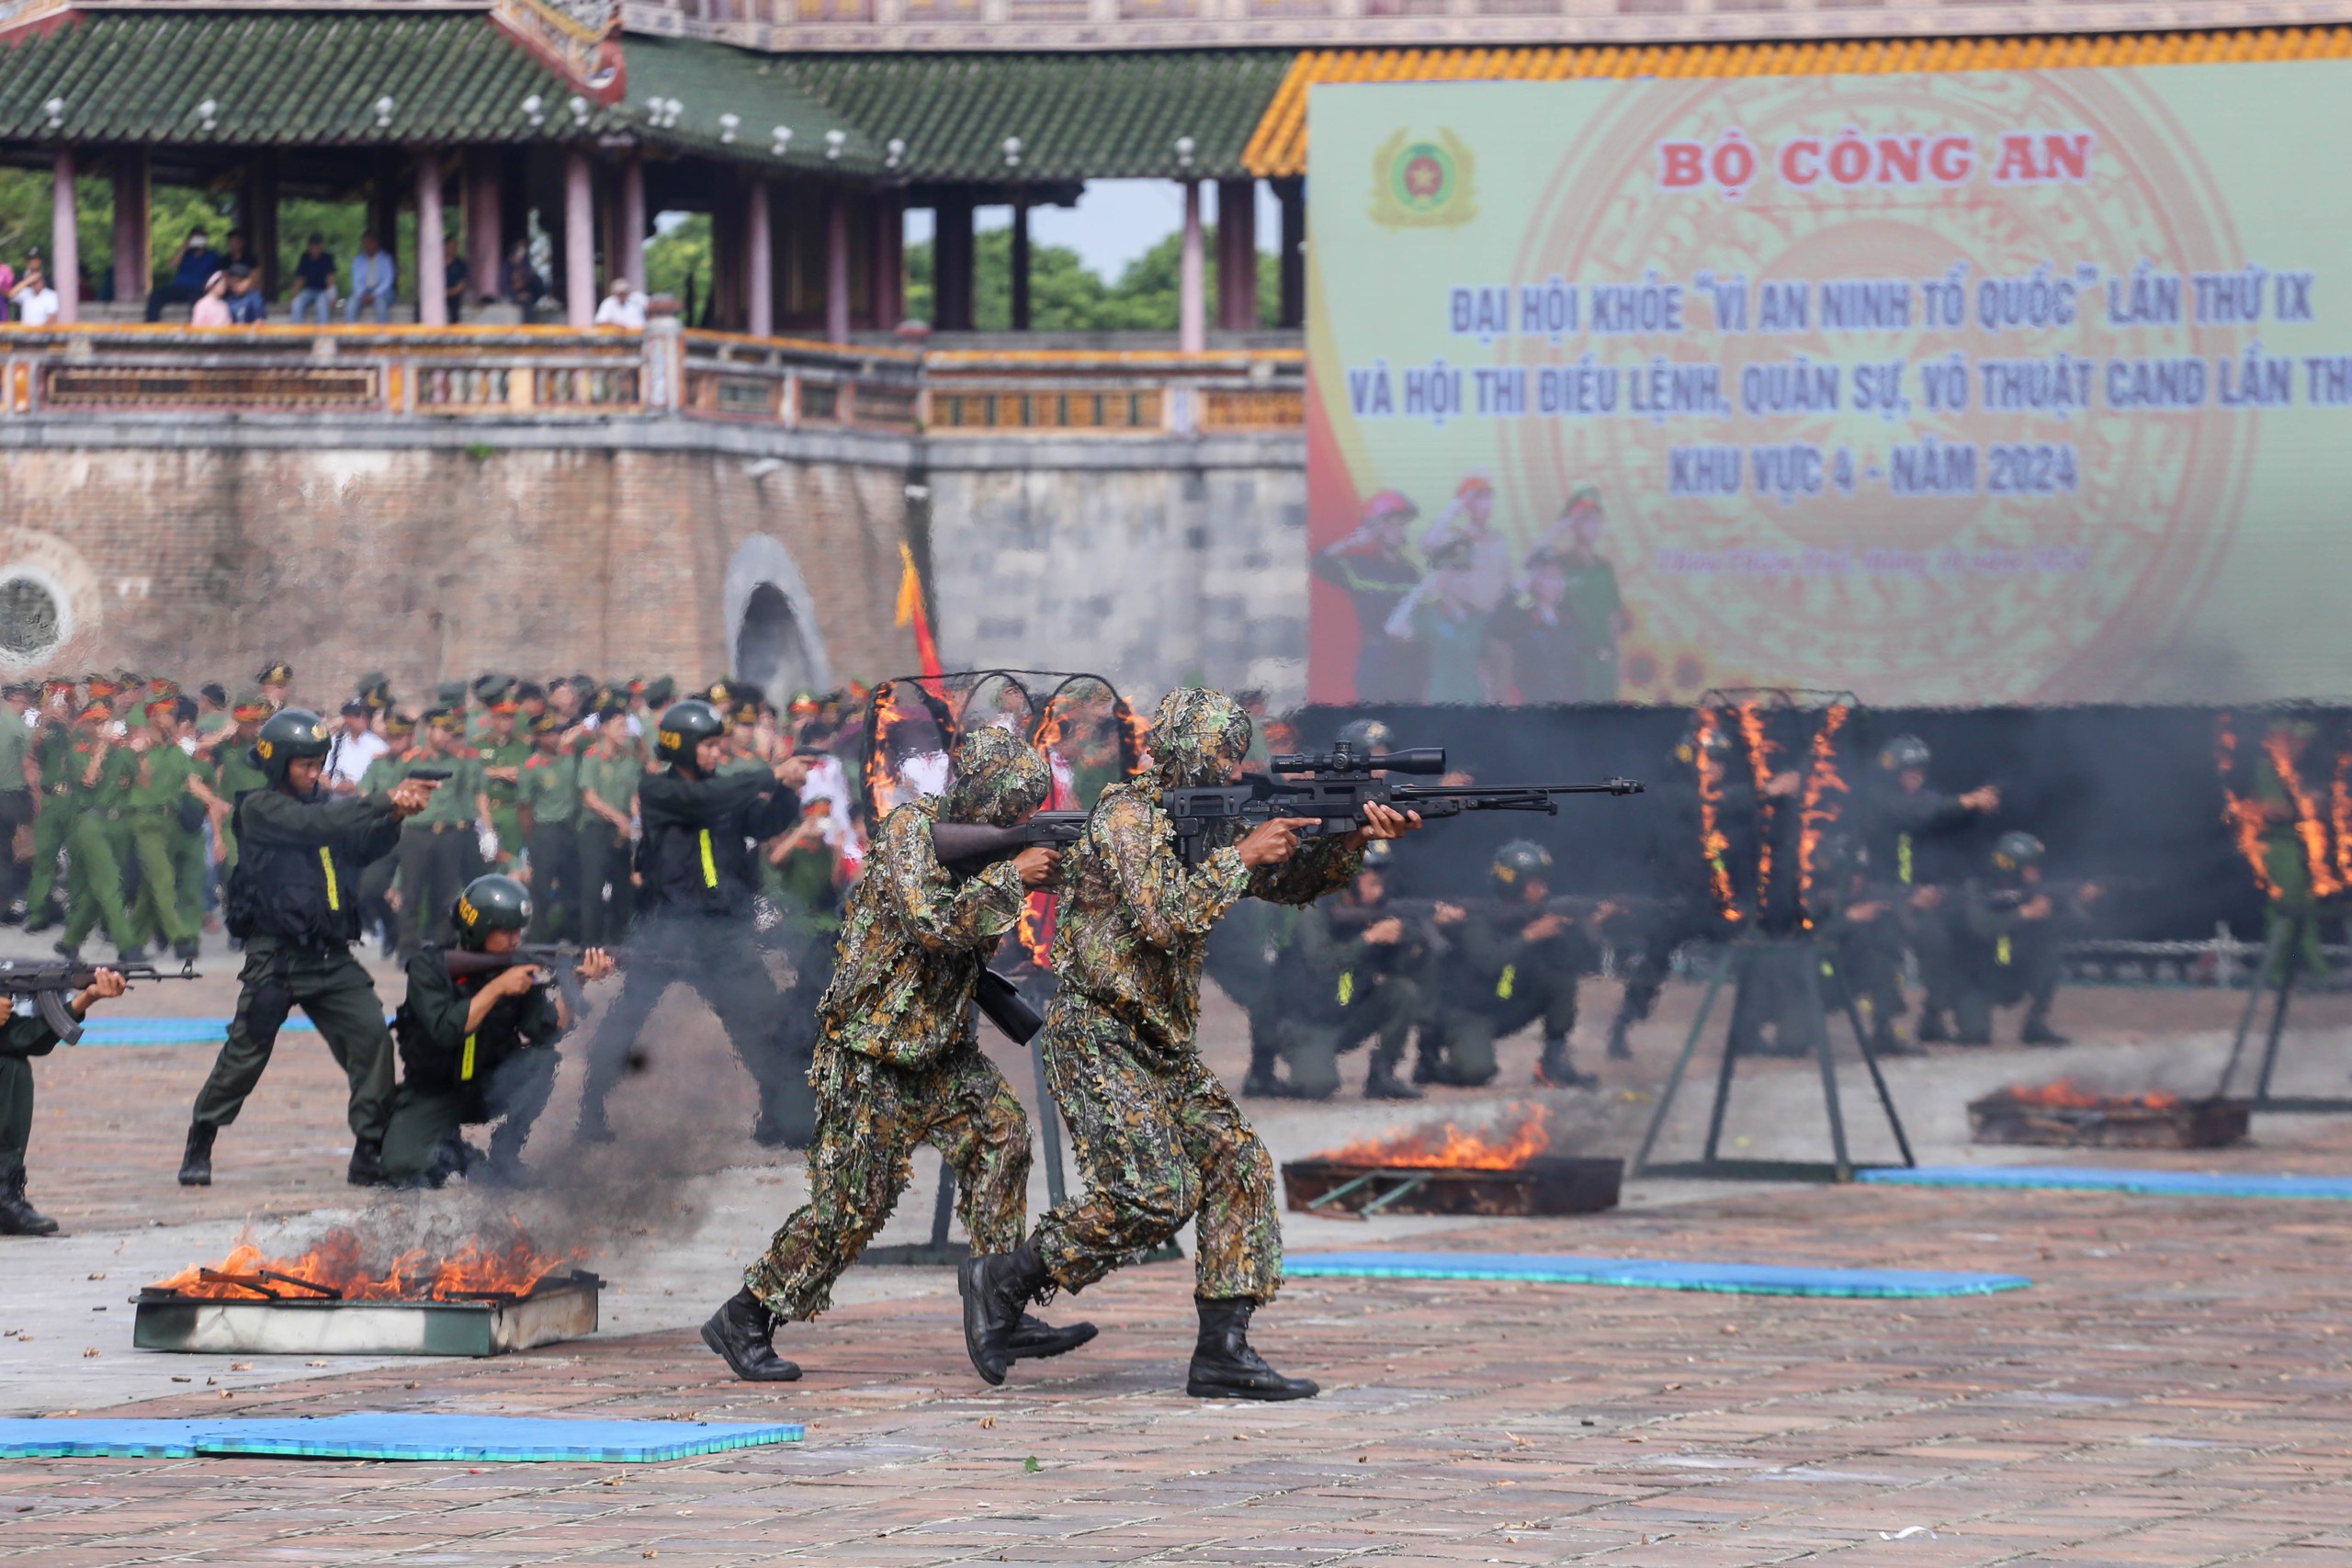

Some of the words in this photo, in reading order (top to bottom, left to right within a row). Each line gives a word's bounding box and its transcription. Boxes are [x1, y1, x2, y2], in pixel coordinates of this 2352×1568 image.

[1660, 130, 1756, 197] BỘ
[1780, 129, 1972, 186] CÔNG
[1996, 134, 2090, 182] AN
[1452, 287, 1509, 344] ĐẠI
[1521, 276, 1577, 344] HỘI
[1758, 282, 1810, 331] AN
[1819, 280, 1910, 329] NINH
[2275, 271, 2314, 321] IX
[1348, 357, 1394, 415] VÀ
[1404, 357, 1462, 427] HỘI
[1473, 367, 1527, 415] THI
[1741, 354, 1841, 420] QUÂN
[1979, 350, 2095, 421] THUẬT
[2106, 358, 2207, 410] CAND
[1668, 444, 1741, 496] KHU
[1750, 439, 1824, 507] VỰC
[1831, 446, 1855, 496] 4
[1891, 434, 1977, 495] NĂM
[1987, 443, 2077, 494] 2024
